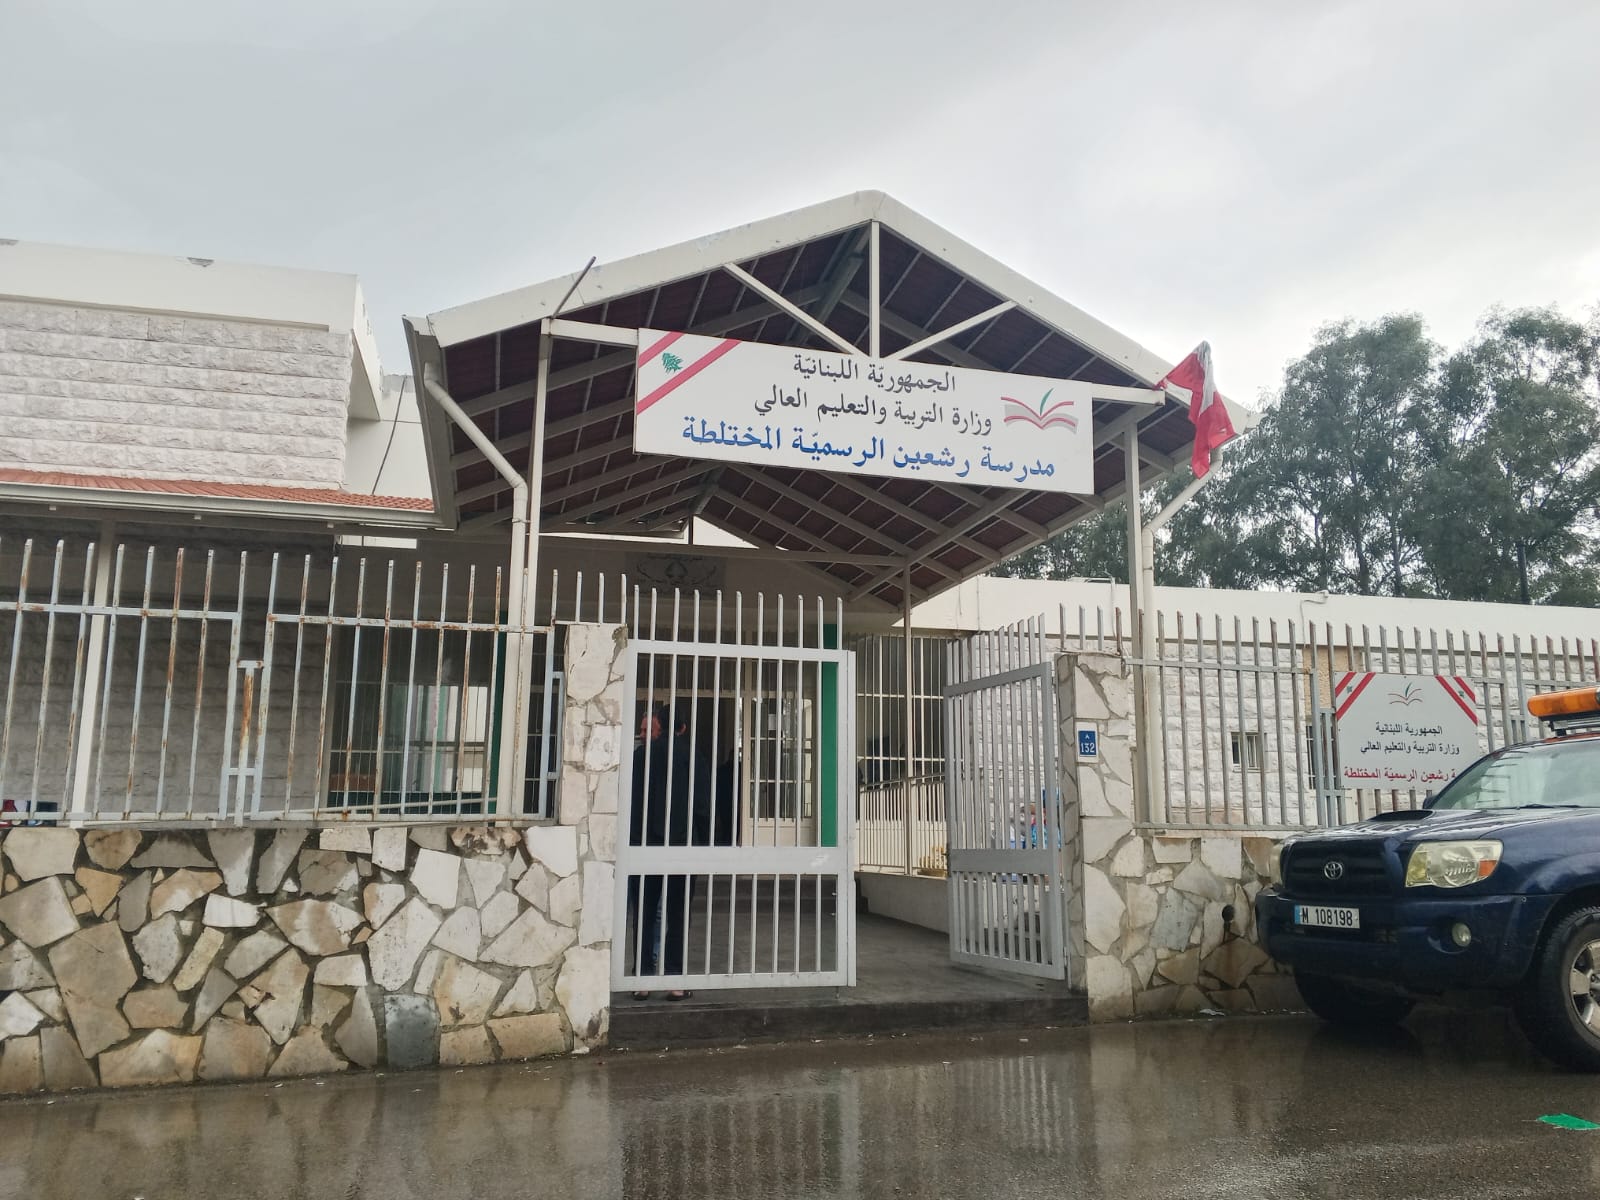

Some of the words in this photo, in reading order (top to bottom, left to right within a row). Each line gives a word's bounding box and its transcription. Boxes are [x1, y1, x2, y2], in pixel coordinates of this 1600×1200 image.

[754, 384, 808, 417] العالي
[817, 393, 887, 424] والتعليم
[893, 400, 943, 430] التربية
[952, 407, 992, 436] وزارة
[682, 415, 781, 451] المختلطة
[893, 446, 970, 478] رشعين
[980, 446, 1055, 482] مدرسة
[1375, 721, 1403, 735] اللبنانية
[1405, 722, 1443, 736] الجمهورية
[1360, 740, 1382, 754] العالي
[1384, 741, 1412, 754] والتعليم
[1413, 740, 1437, 754] التربية
[1439, 742, 1460, 755] وزارة
[1343, 766, 1381, 779] المختلطة
[1420, 769, 1449, 783] رشعين
[1302, 907, 1309, 924] M
[1315, 908, 1353, 927] 108198
